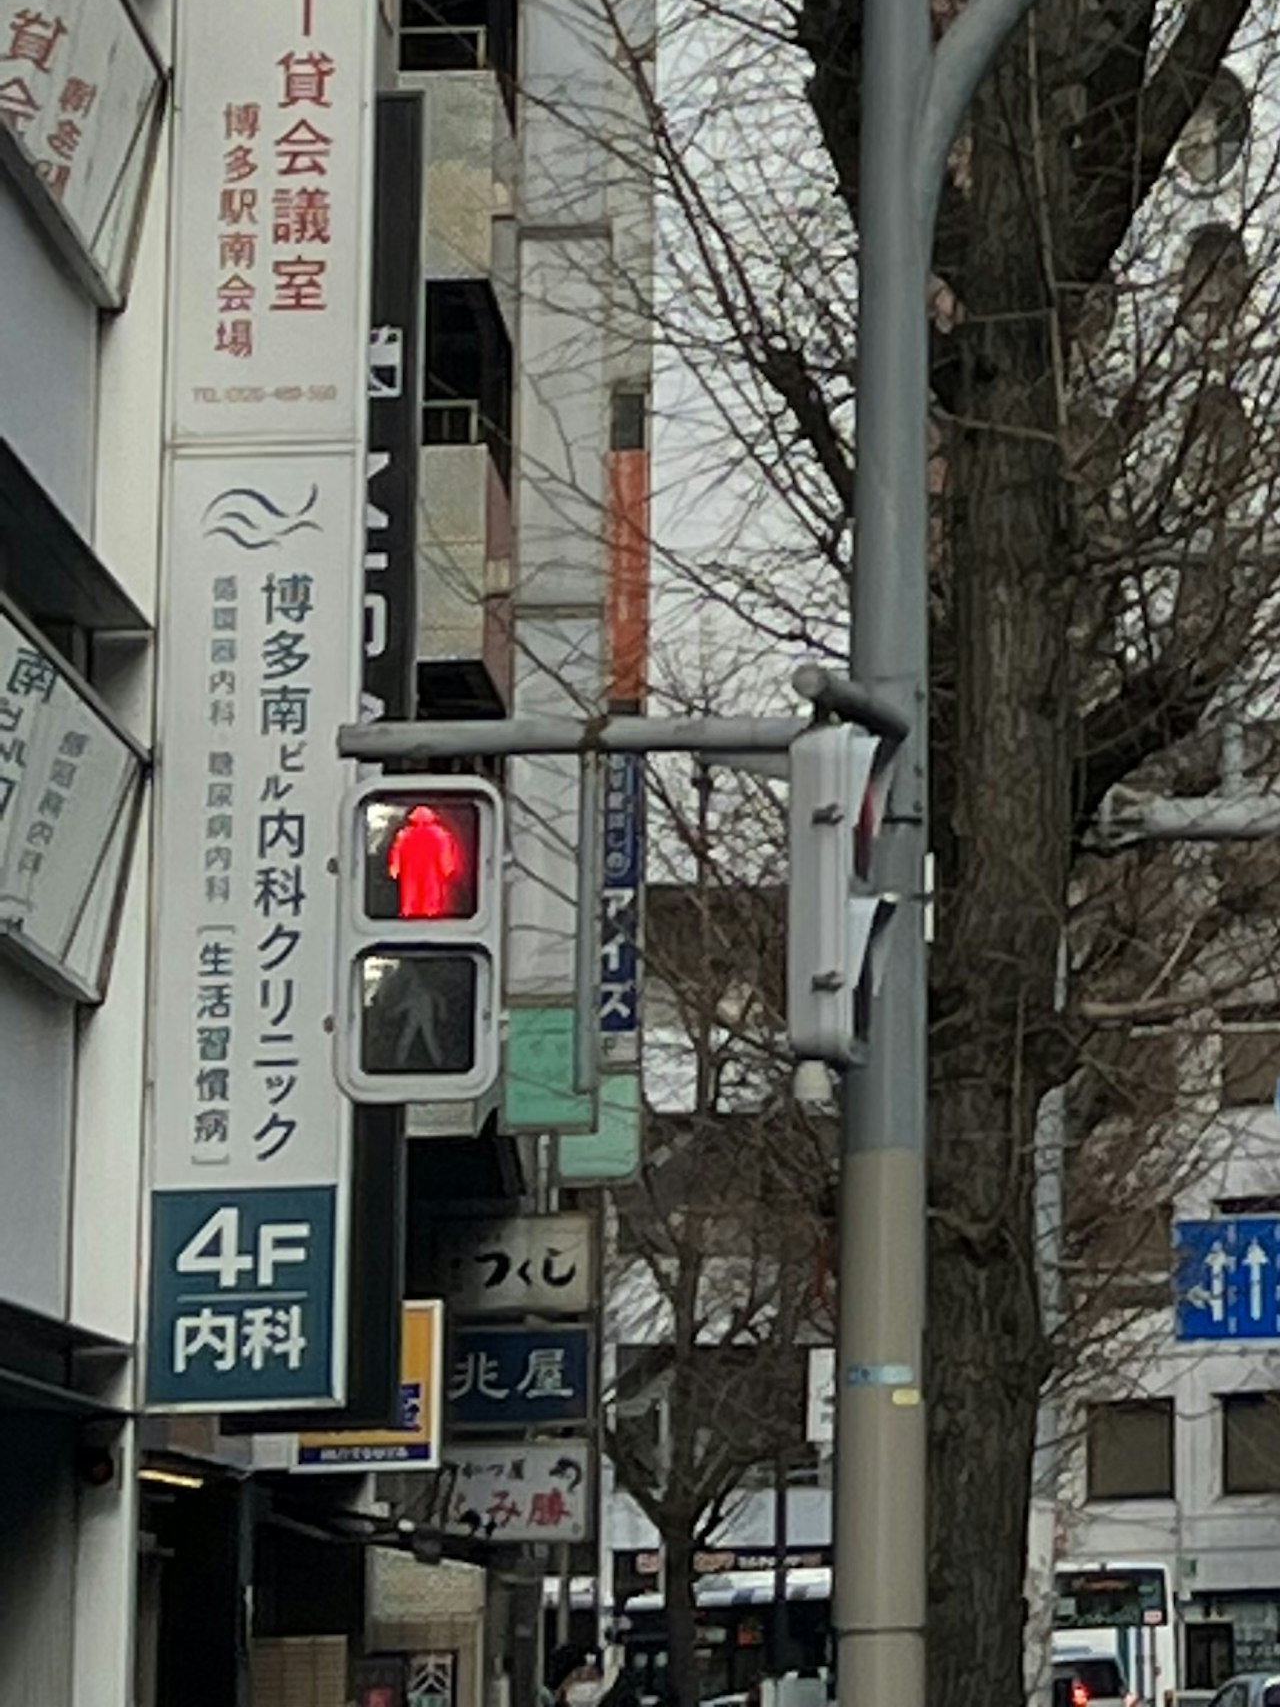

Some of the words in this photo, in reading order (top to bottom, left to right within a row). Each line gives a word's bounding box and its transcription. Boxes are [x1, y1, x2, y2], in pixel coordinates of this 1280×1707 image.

[213, 101, 261, 358] 博多駅南会場
[252, 573, 314, 1162] 博多南ビル内科クリニック
[176, 1206, 311, 1288] 4F
[173, 1304, 307, 1374] 内科
